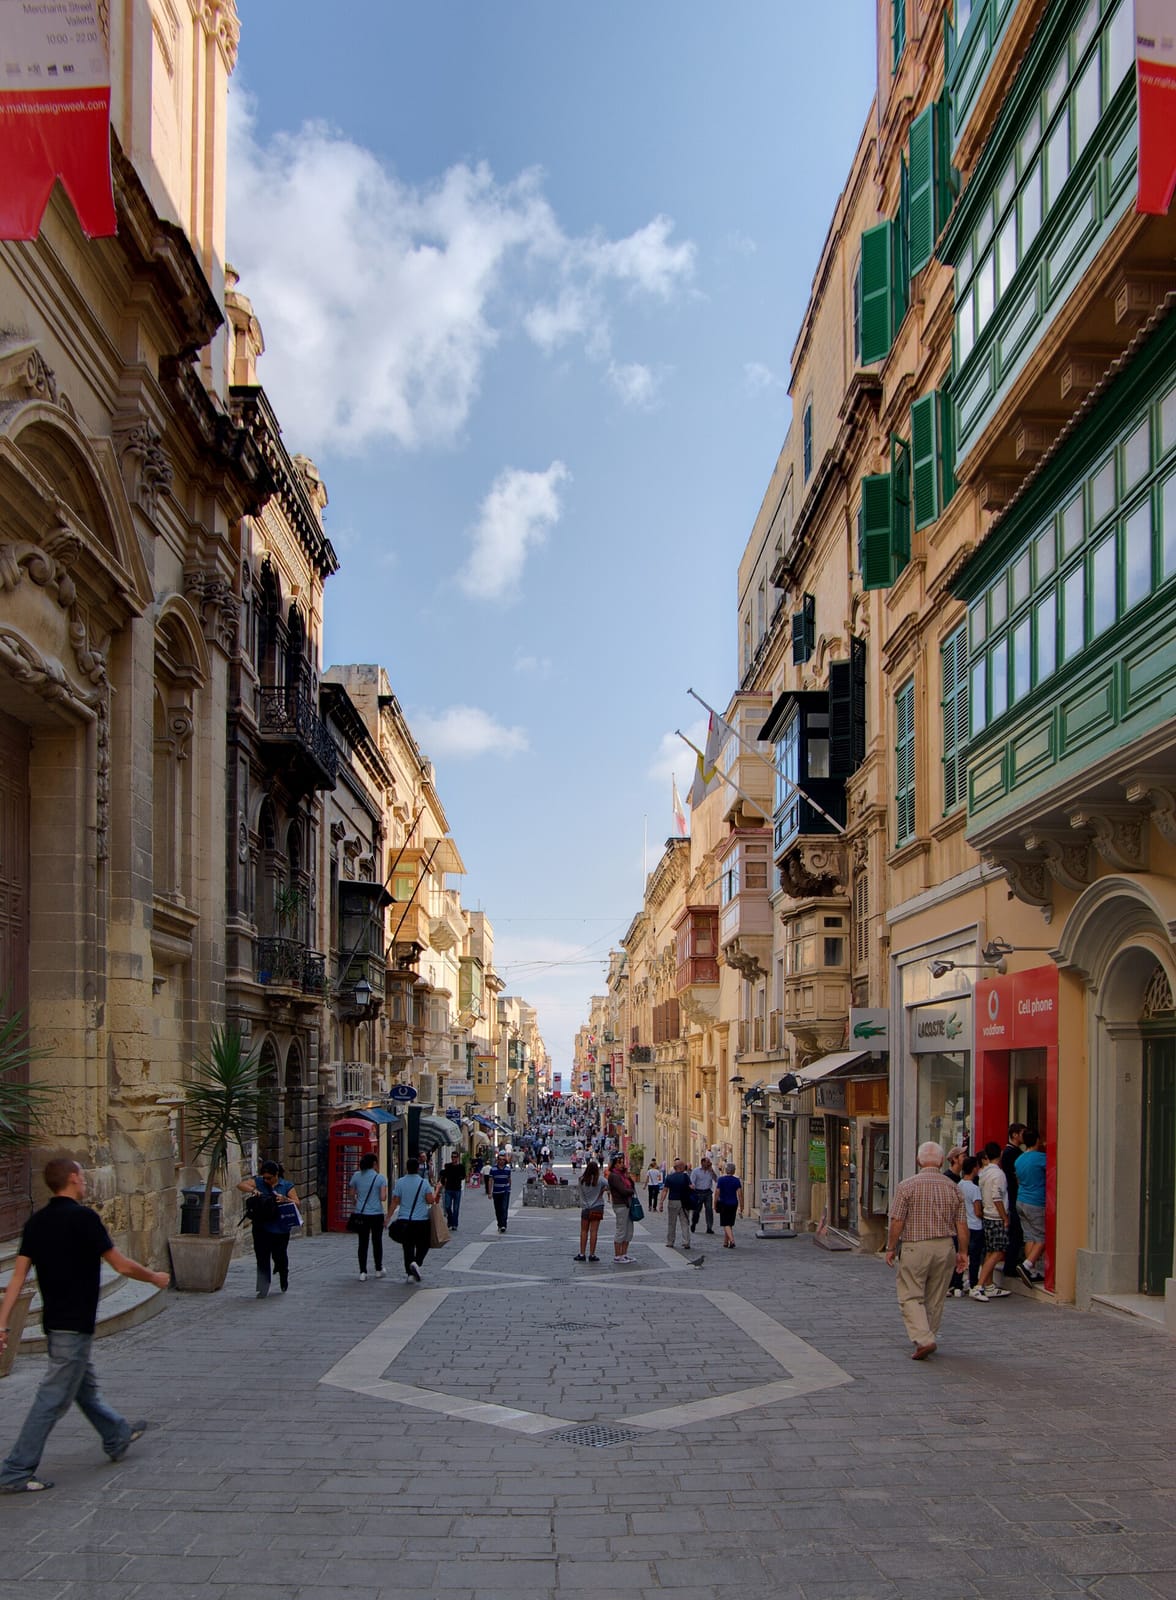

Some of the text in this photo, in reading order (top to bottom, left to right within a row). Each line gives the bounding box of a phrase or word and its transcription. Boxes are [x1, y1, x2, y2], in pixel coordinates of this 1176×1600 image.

[22, 2, 93, 14] Merchants Street
[66, 16, 95, 26] Valletta
[1018, 997, 1053, 1016] Cell phone
[917, 1020, 945, 1038] LACOSTE
[983, 1024, 1004, 1036] vodafone
